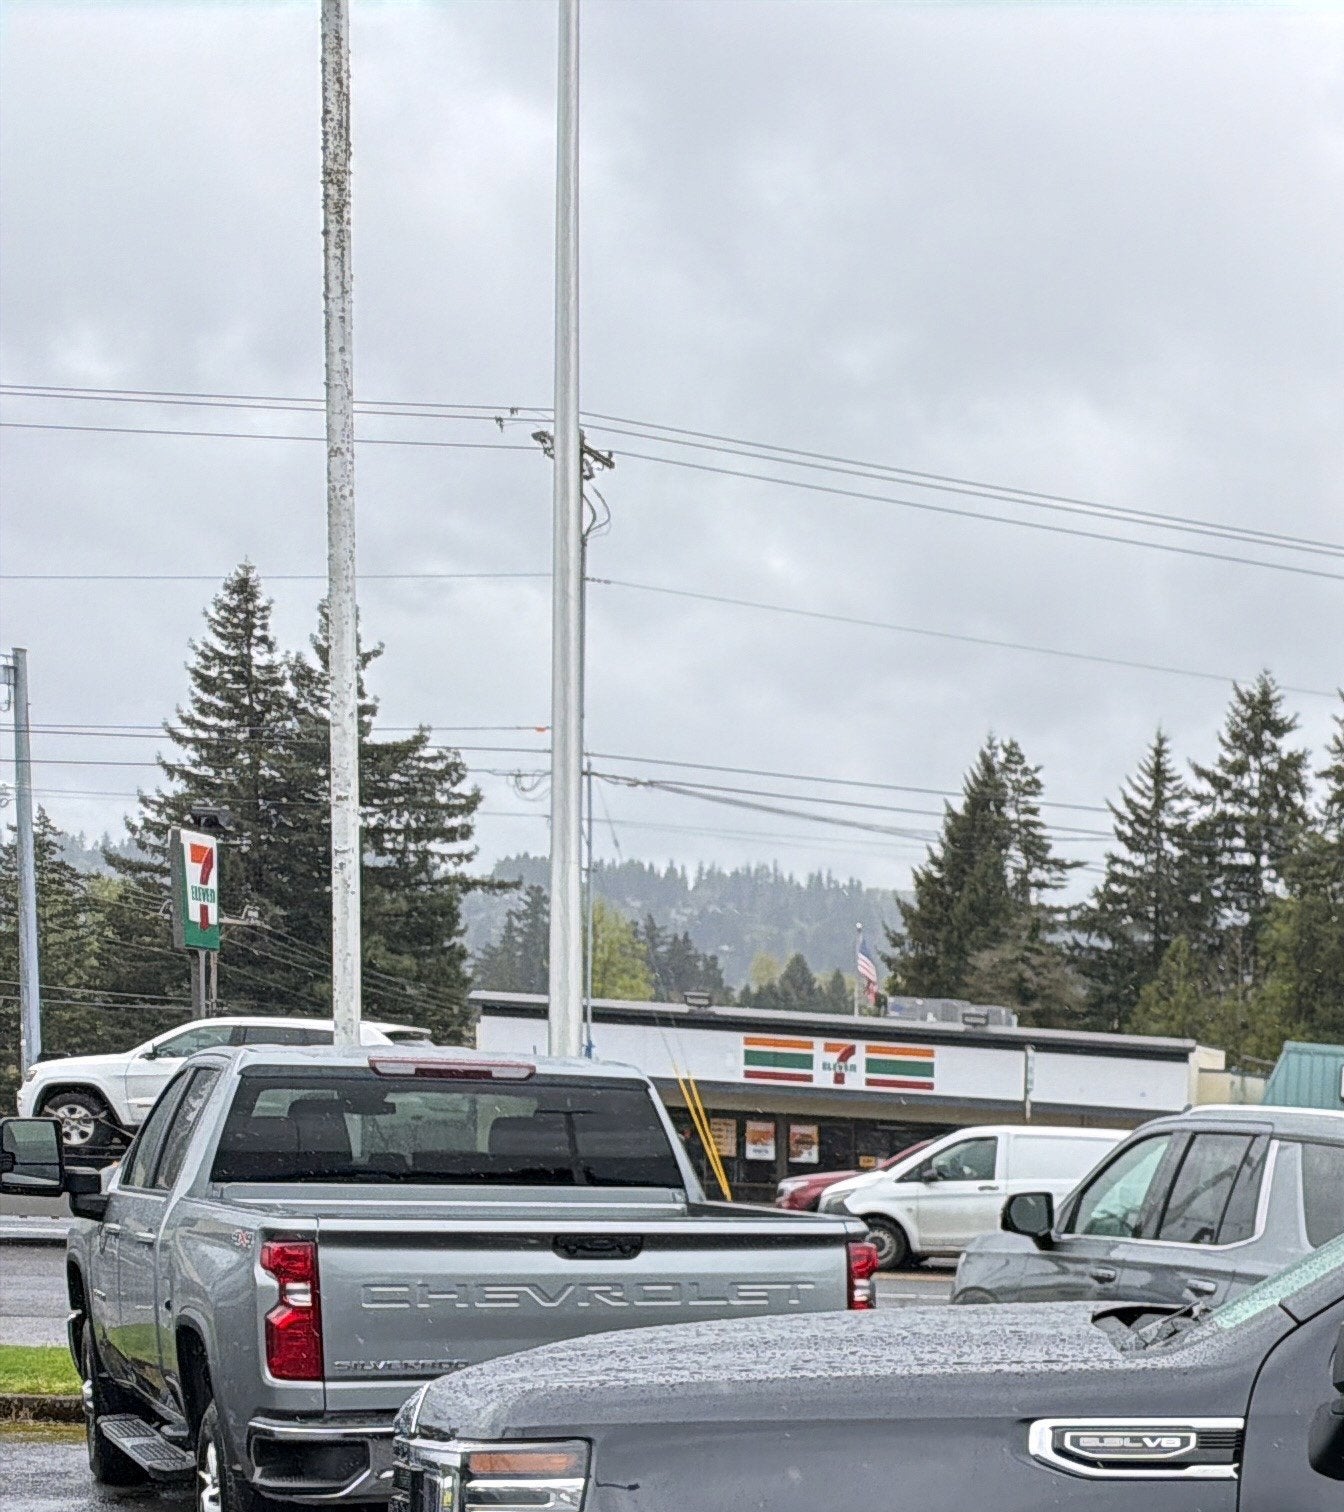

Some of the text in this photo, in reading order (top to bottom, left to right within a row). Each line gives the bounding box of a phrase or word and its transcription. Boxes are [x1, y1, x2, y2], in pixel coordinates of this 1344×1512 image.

[190, 843, 214, 931] 7
[824, 1042, 856, 1085] 7
[362, 1282, 815, 1308] CHEVROLET
[334, 1359, 470, 1372] SILVERADO
